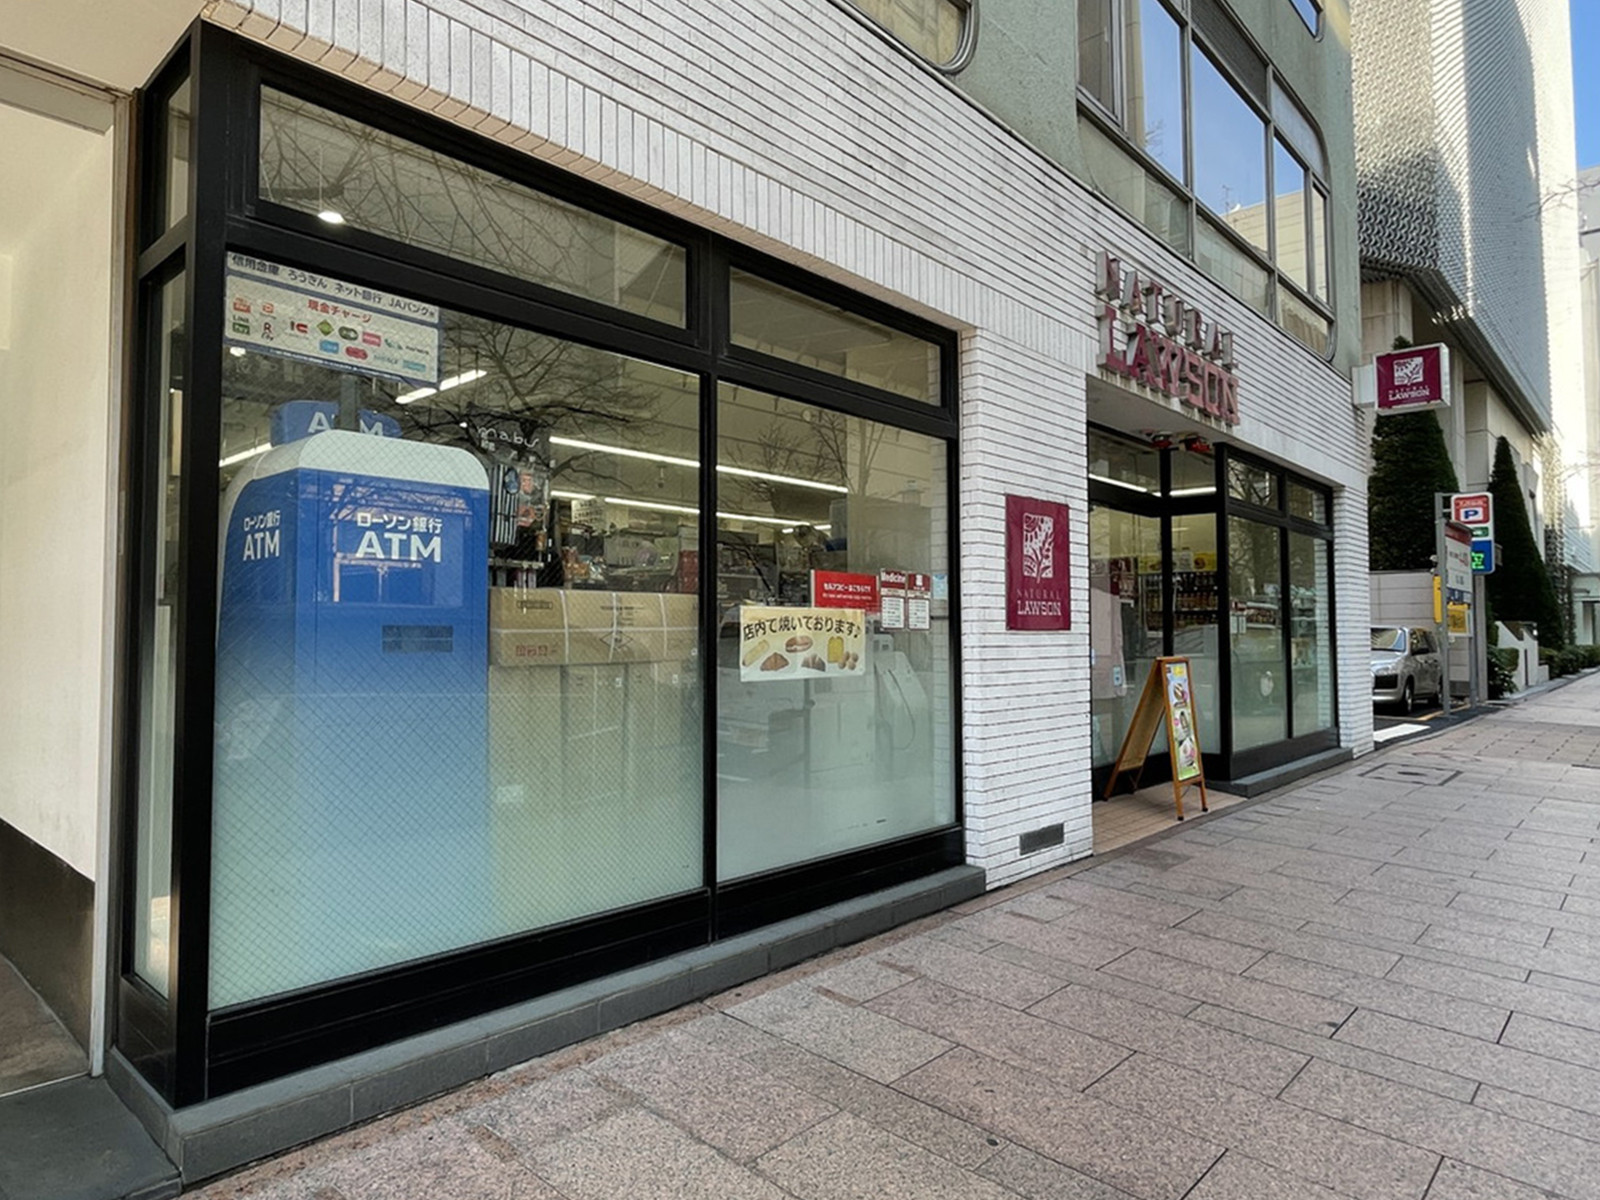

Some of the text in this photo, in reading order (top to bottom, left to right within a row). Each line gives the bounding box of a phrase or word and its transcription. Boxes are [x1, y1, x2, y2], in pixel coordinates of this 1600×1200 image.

[308, 299, 372, 323] 現金チャージ
[1096, 303, 1240, 426] LAWSON
[1388, 388, 1430, 401] LAWSON
[307, 412, 383, 436] AM
[243, 510, 281, 531] ローソン銀行
[357, 512, 443, 534] ローソン銀行
[1463, 509, 1479, 519] P
[243, 529, 280, 561] ATM
[355, 530, 442, 563] ATM
[1016, 588, 1061, 600] NATURAL
[1017, 600, 1062, 615] LAWSON
